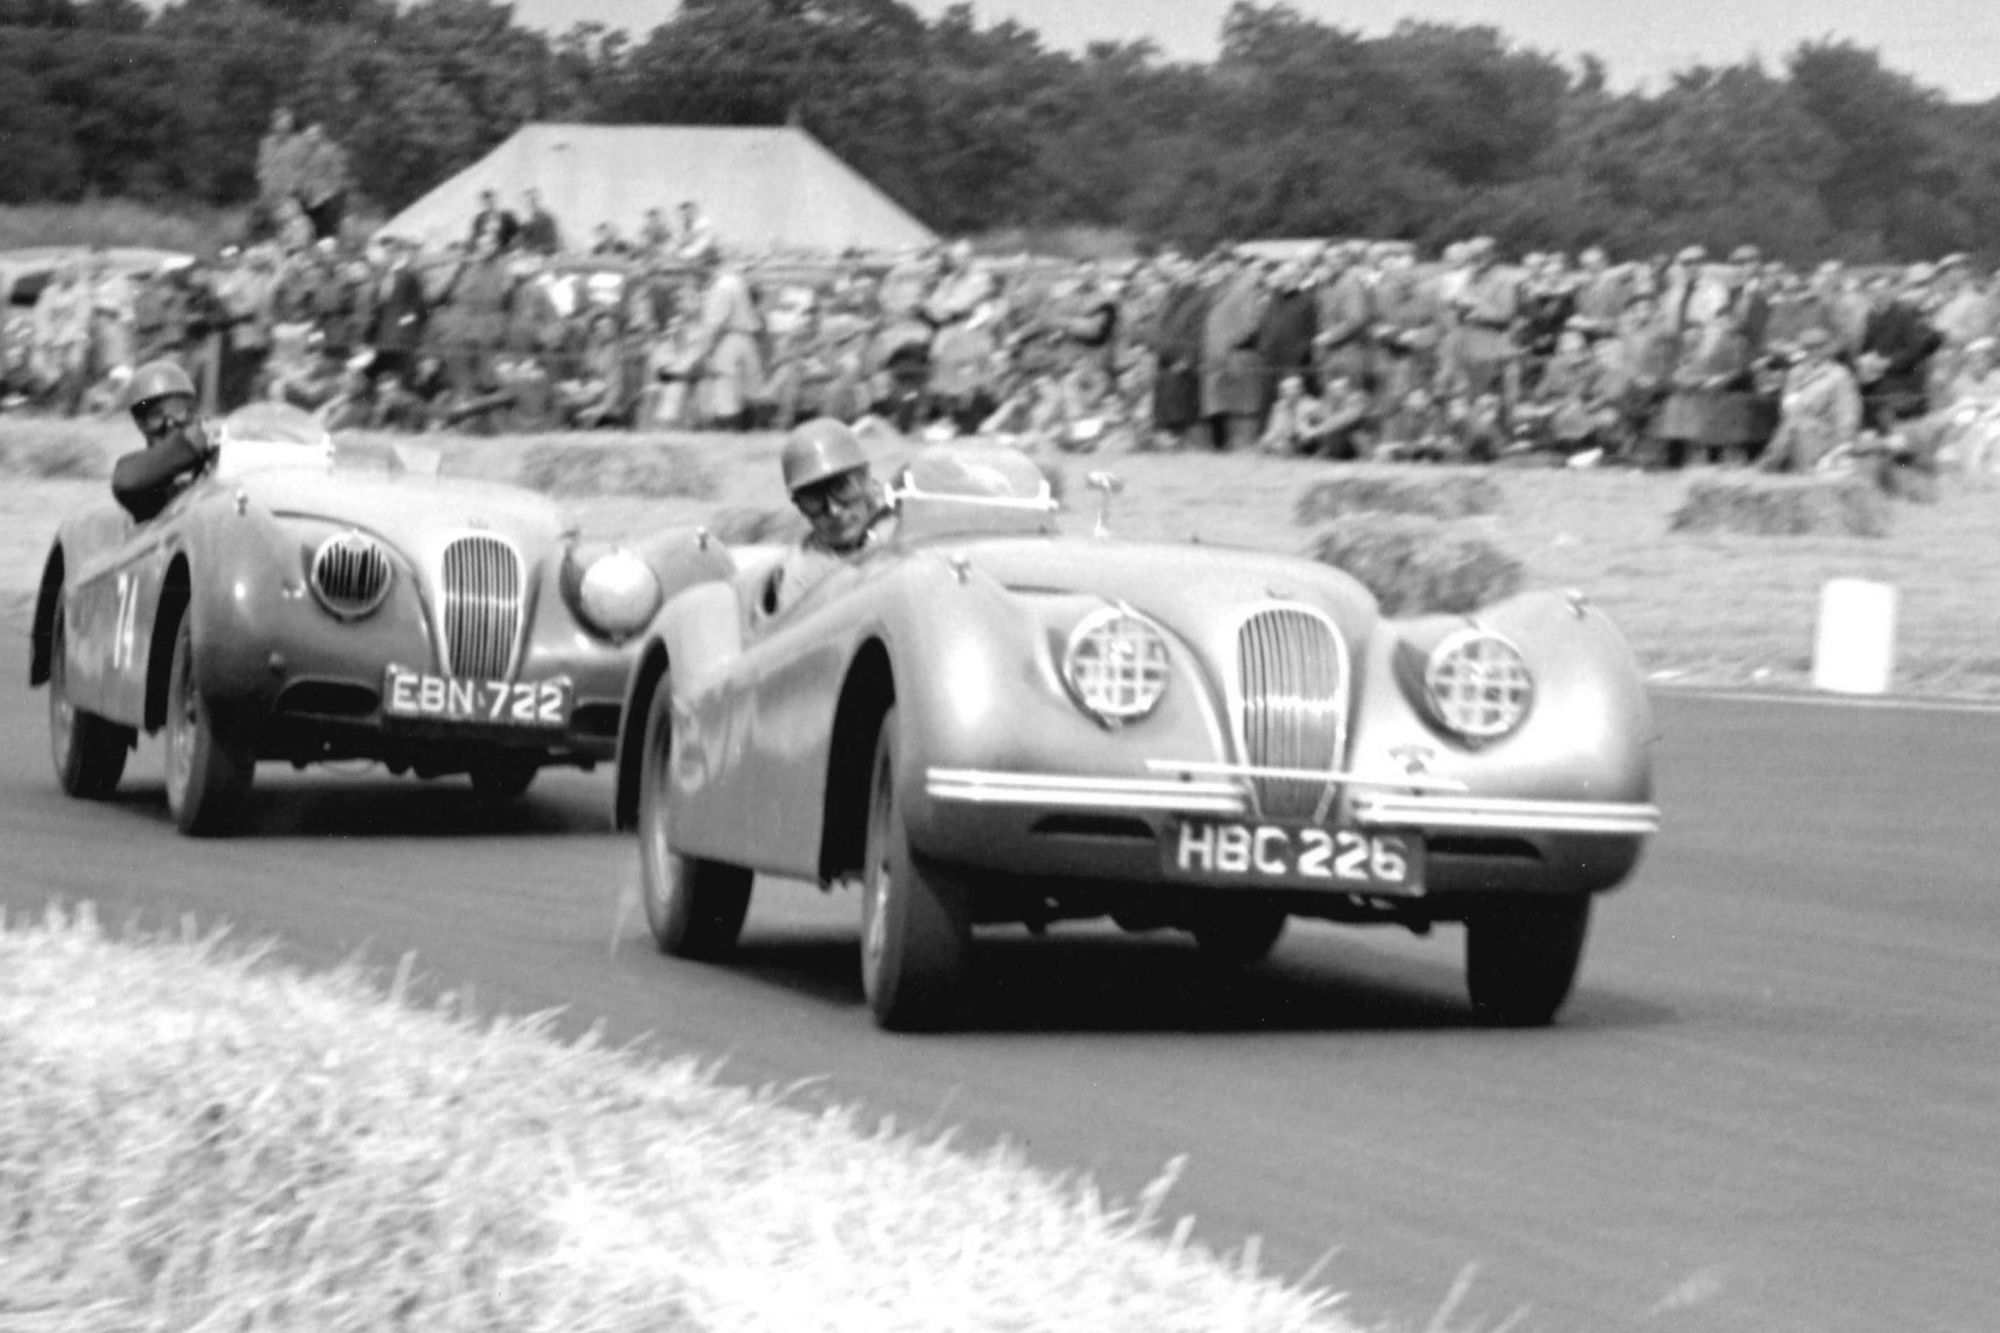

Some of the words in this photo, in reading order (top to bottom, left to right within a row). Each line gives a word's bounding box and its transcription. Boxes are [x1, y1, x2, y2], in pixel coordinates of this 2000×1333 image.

[392, 674, 474, 714] EBN
[486, 680, 563, 722] 722
[1177, 822, 1288, 875] HBC
[1298, 828, 1407, 882] 226
